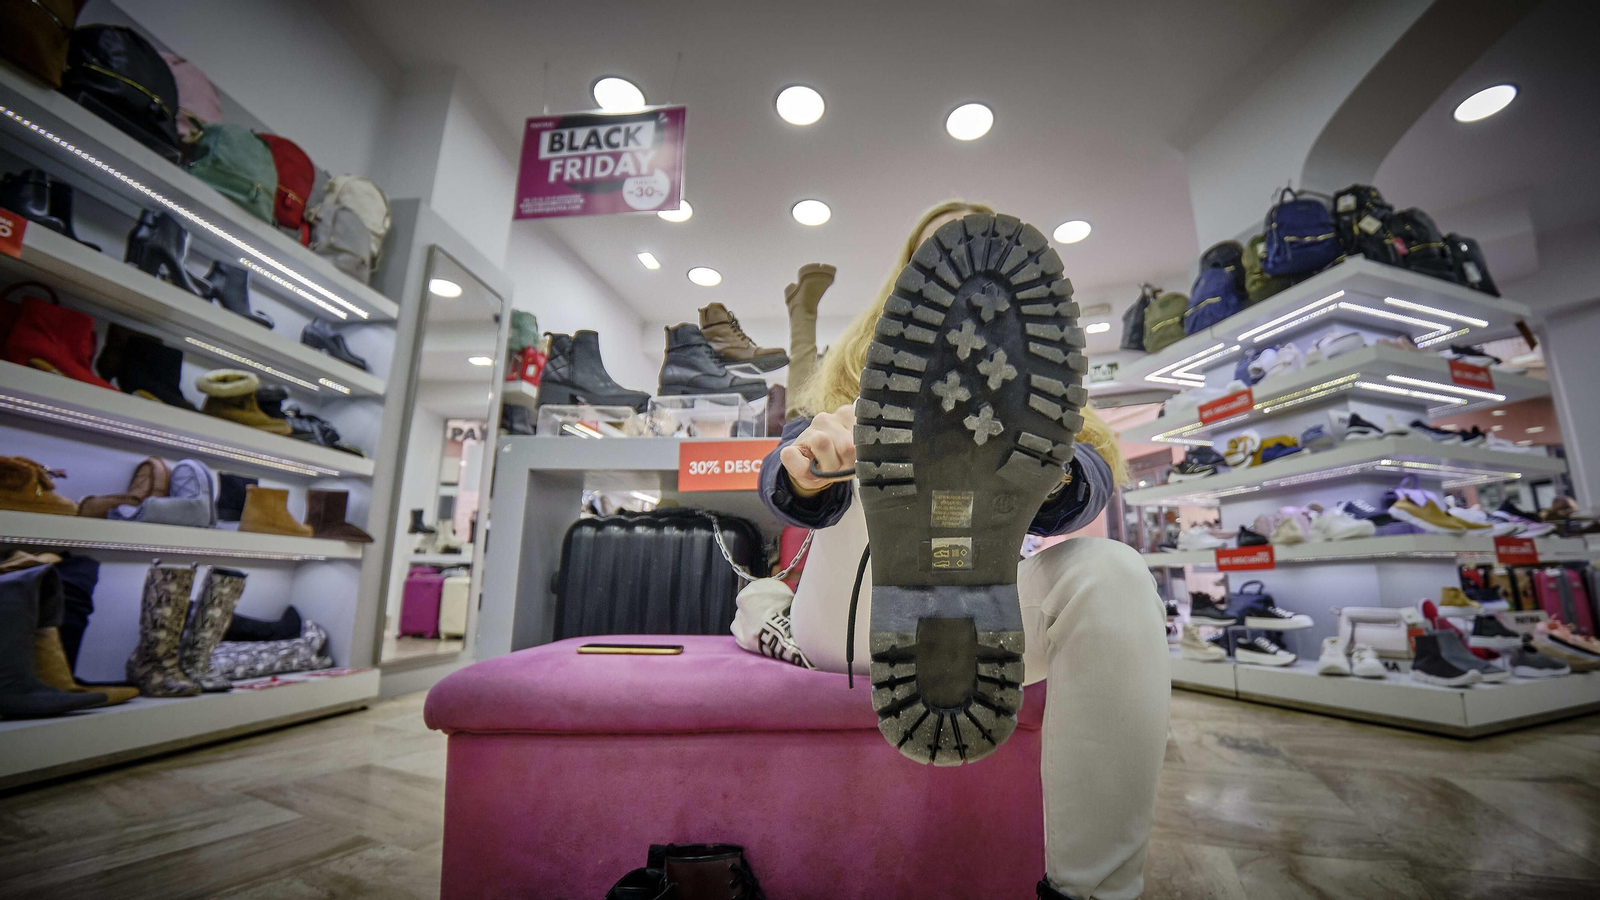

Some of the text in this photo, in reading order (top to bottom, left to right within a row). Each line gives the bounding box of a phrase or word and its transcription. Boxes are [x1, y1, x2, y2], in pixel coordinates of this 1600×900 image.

[548, 126, 643, 153] BLACK
[548, 151, 655, 183] FRIDAY
[627, 186, 664, 197] -30%
[688, 459, 763, 475] 30% DESC
